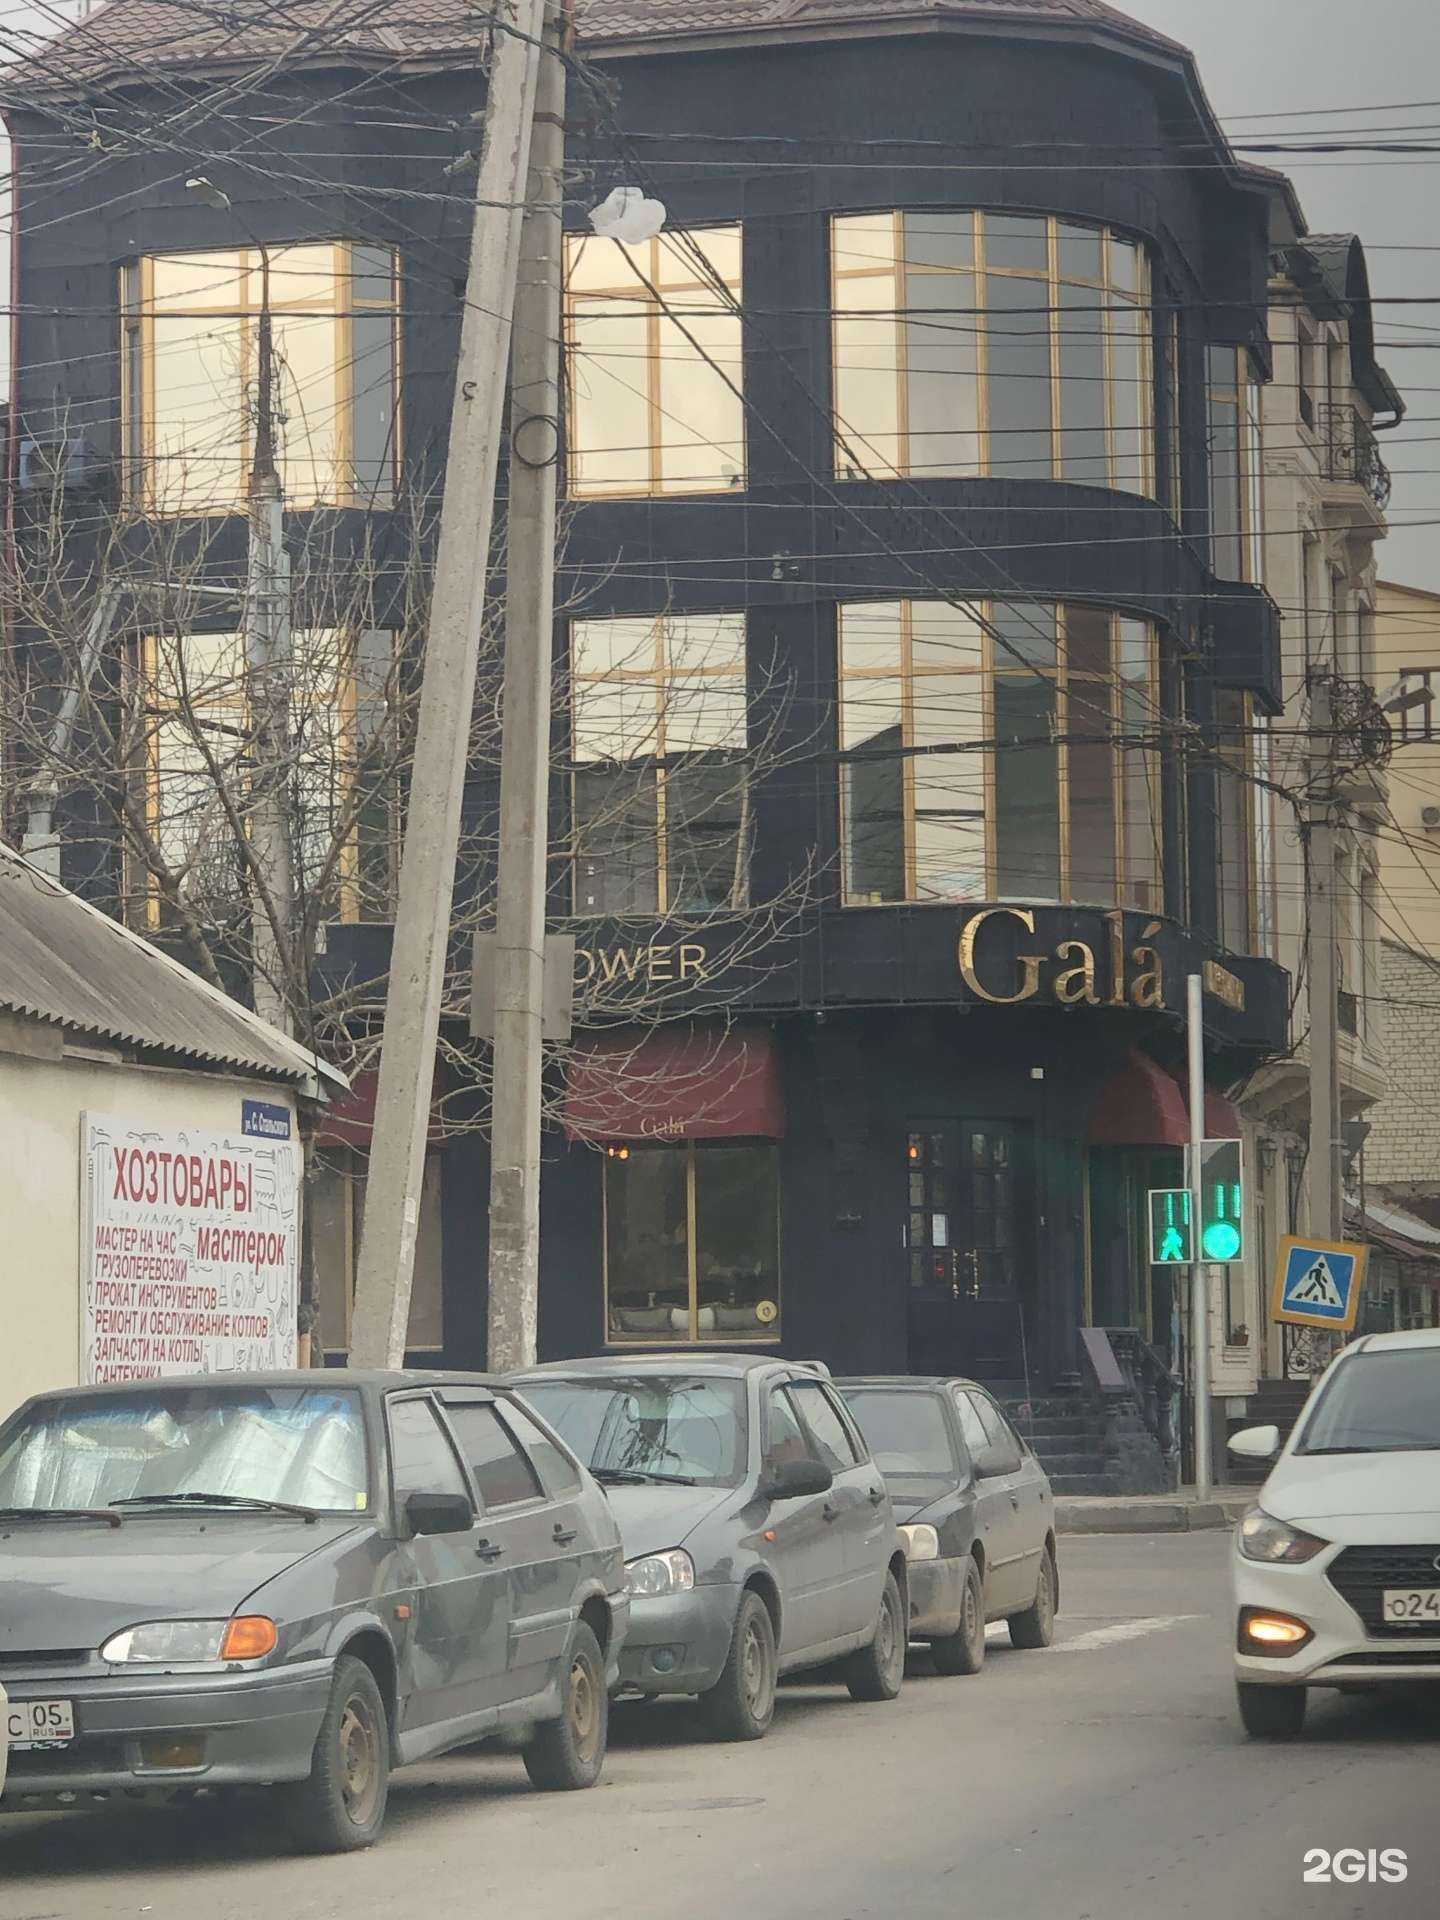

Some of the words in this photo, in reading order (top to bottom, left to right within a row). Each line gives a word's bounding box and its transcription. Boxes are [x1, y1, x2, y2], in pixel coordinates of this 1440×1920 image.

[958, 907, 1167, 1010] Galá
[113, 1146, 252, 1213] ХОЗТОВАРЫ
[95, 1225, 138, 1252] МАСТЕР
[139, 1228, 154, 1253] НА
[155, 1231, 177, 1255] ЧАС
[196, 1226, 287, 1275] мастерок
[95, 1253, 188, 1283] ГРУЗОПЕРЕВОЗКИ
[94, 1281, 137, 1307] ПРОКАТ
[138, 1284, 218, 1310] ИНСТРУМЕНТОВ
[94, 1309, 139, 1334] РЕМОНТ
[139, 1312, 148, 1335] И
[149, 1312, 230, 1338] ОБСЛУЖИВАНИЕ
[231, 1315, 269, 1339] КОТЛОВ
[94, 1337, 150, 1362] ЗАПЧАСТИ
[152, 1339, 167, 1362] НА
[168, 1340, 204, 1363] КОТЛЫ
[33, 1704, 62, 1727] 05
[32, 1728, 55, 1737] RUS
